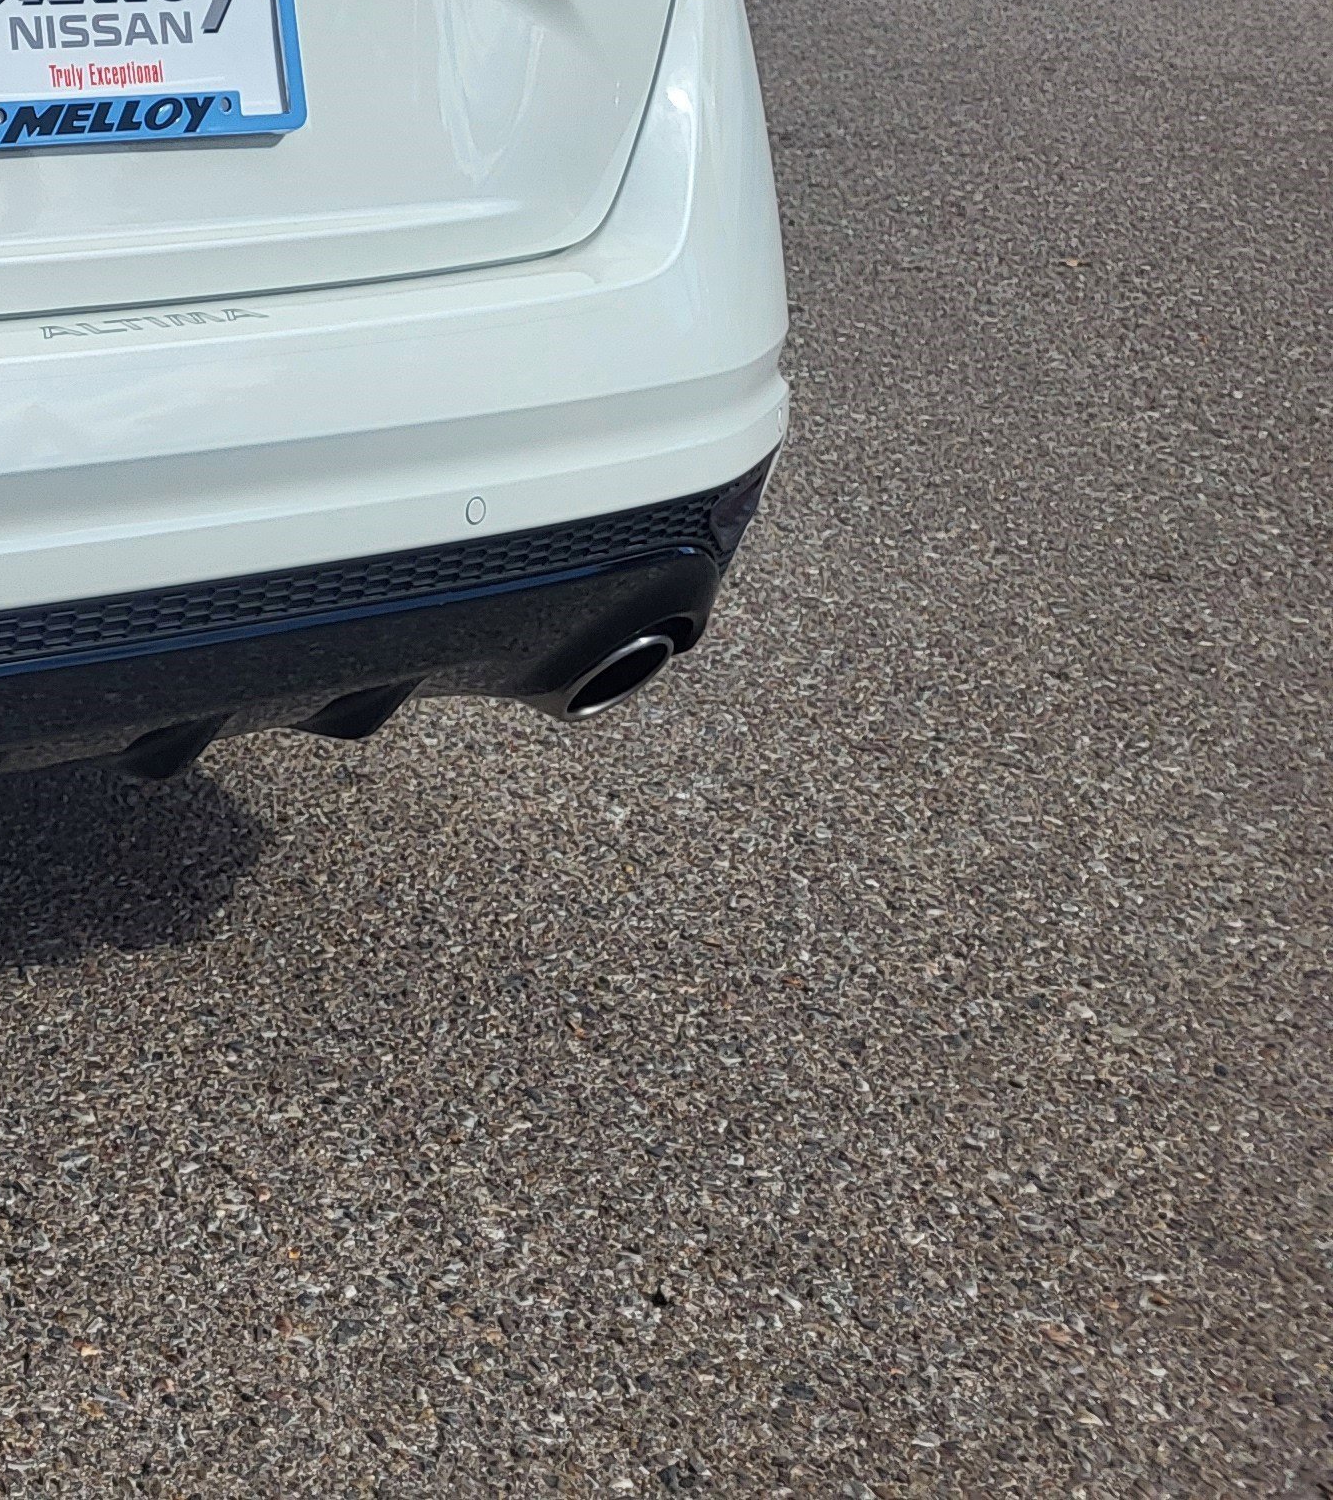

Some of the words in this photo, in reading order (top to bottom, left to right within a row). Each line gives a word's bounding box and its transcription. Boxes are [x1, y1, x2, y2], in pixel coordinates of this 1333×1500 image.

[8, 11, 194, 51] NISSAN
[48, 64, 83, 90] Truly
[89, 60, 164, 88] Exceptional
[0, 96, 216, 144] MELLOY
[39, 307, 270, 340] ALTIMA
